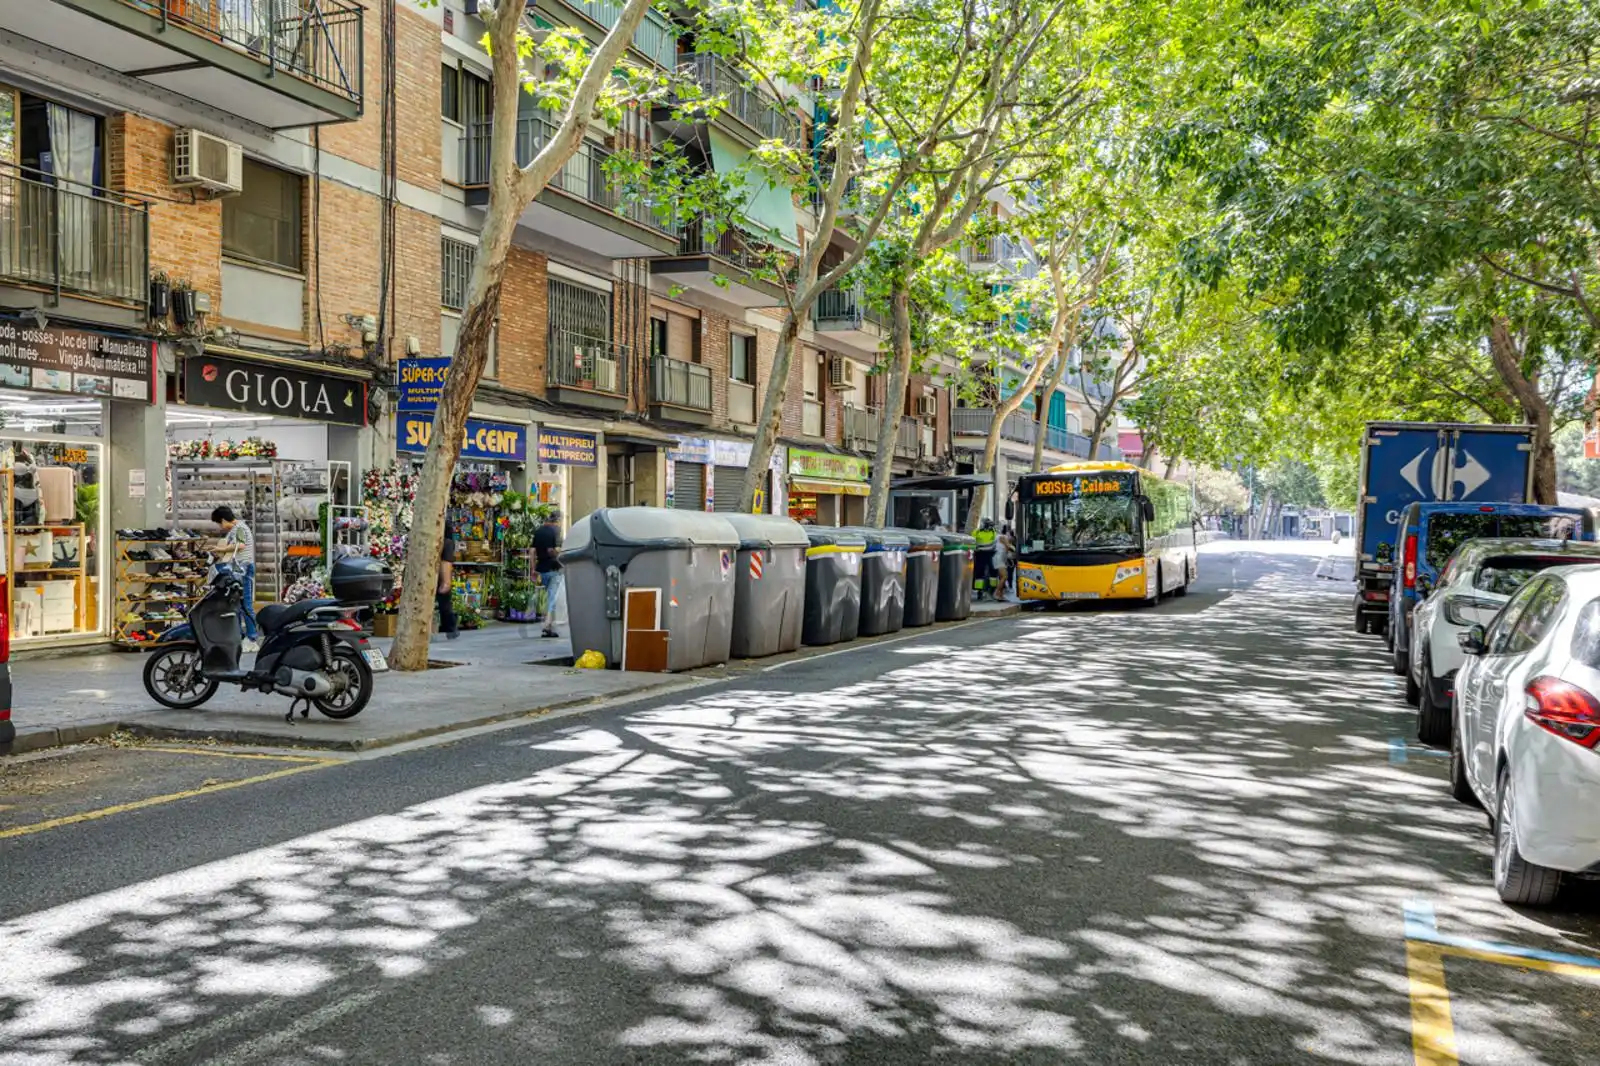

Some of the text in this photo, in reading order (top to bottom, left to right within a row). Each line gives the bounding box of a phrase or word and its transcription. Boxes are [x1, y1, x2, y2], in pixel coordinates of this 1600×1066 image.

[0, 323, 16, 338] oda
[22, 329, 54, 345] Bosses
[59, 332, 75, 348] Joc
[76, 334, 87, 349] de
[58, 349, 83, 370] Vinga
[105, 356, 137, 374] mateixa
[401, 367, 449, 383] SUPER-CE
[539, 434, 595, 449] MULTIPREU
[539, 447, 595, 462] MULTIPRECIO
